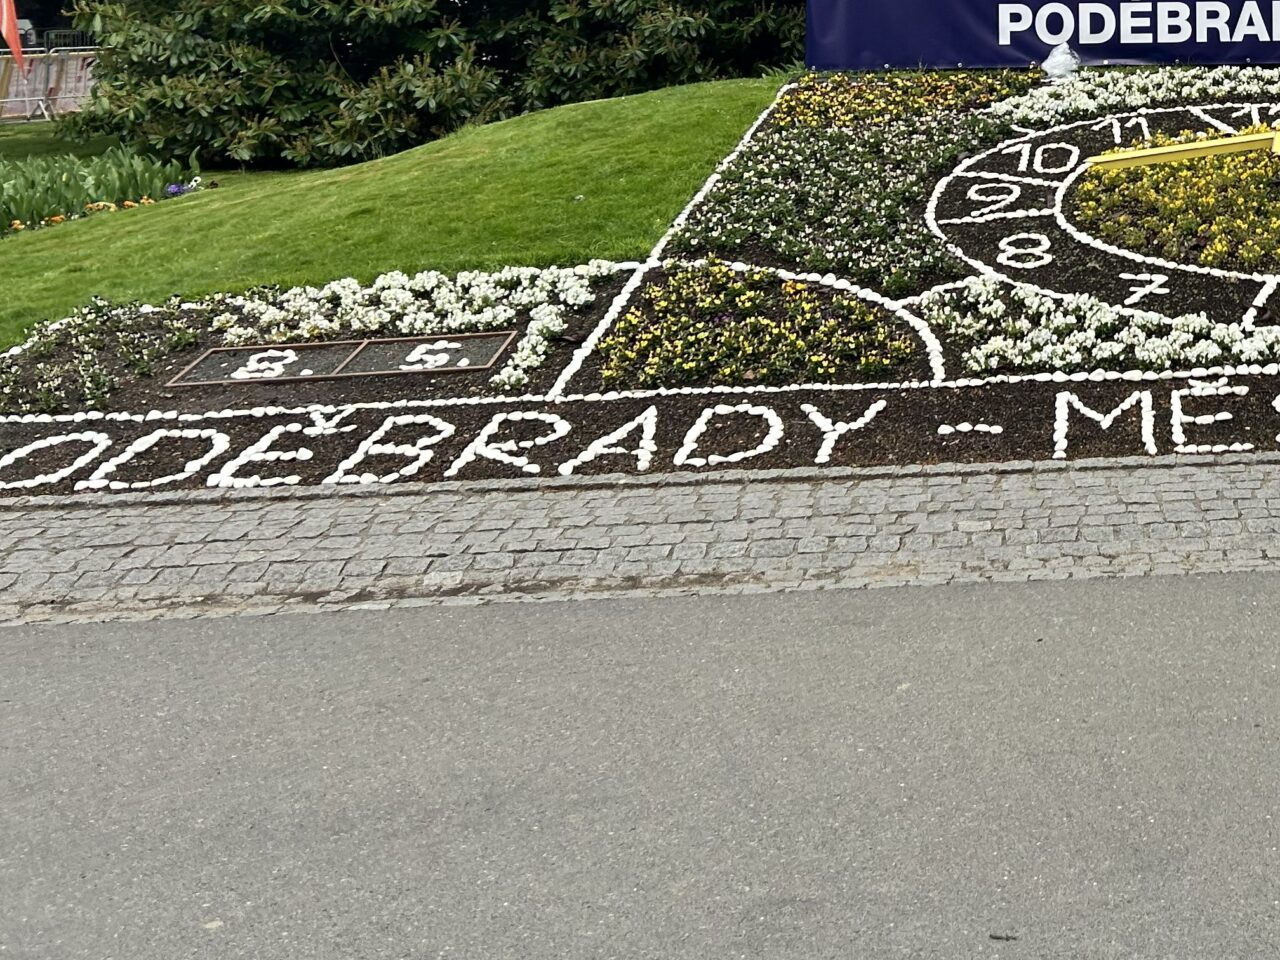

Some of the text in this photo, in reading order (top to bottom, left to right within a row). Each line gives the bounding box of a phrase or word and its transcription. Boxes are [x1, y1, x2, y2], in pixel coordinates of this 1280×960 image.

[1091, 116, 1151, 144] 11
[1001, 142, 1081, 174] 10
[966, 183, 1021, 217] 9
[996, 232, 1053, 269] 8
[1118, 272, 1170, 306] 7
